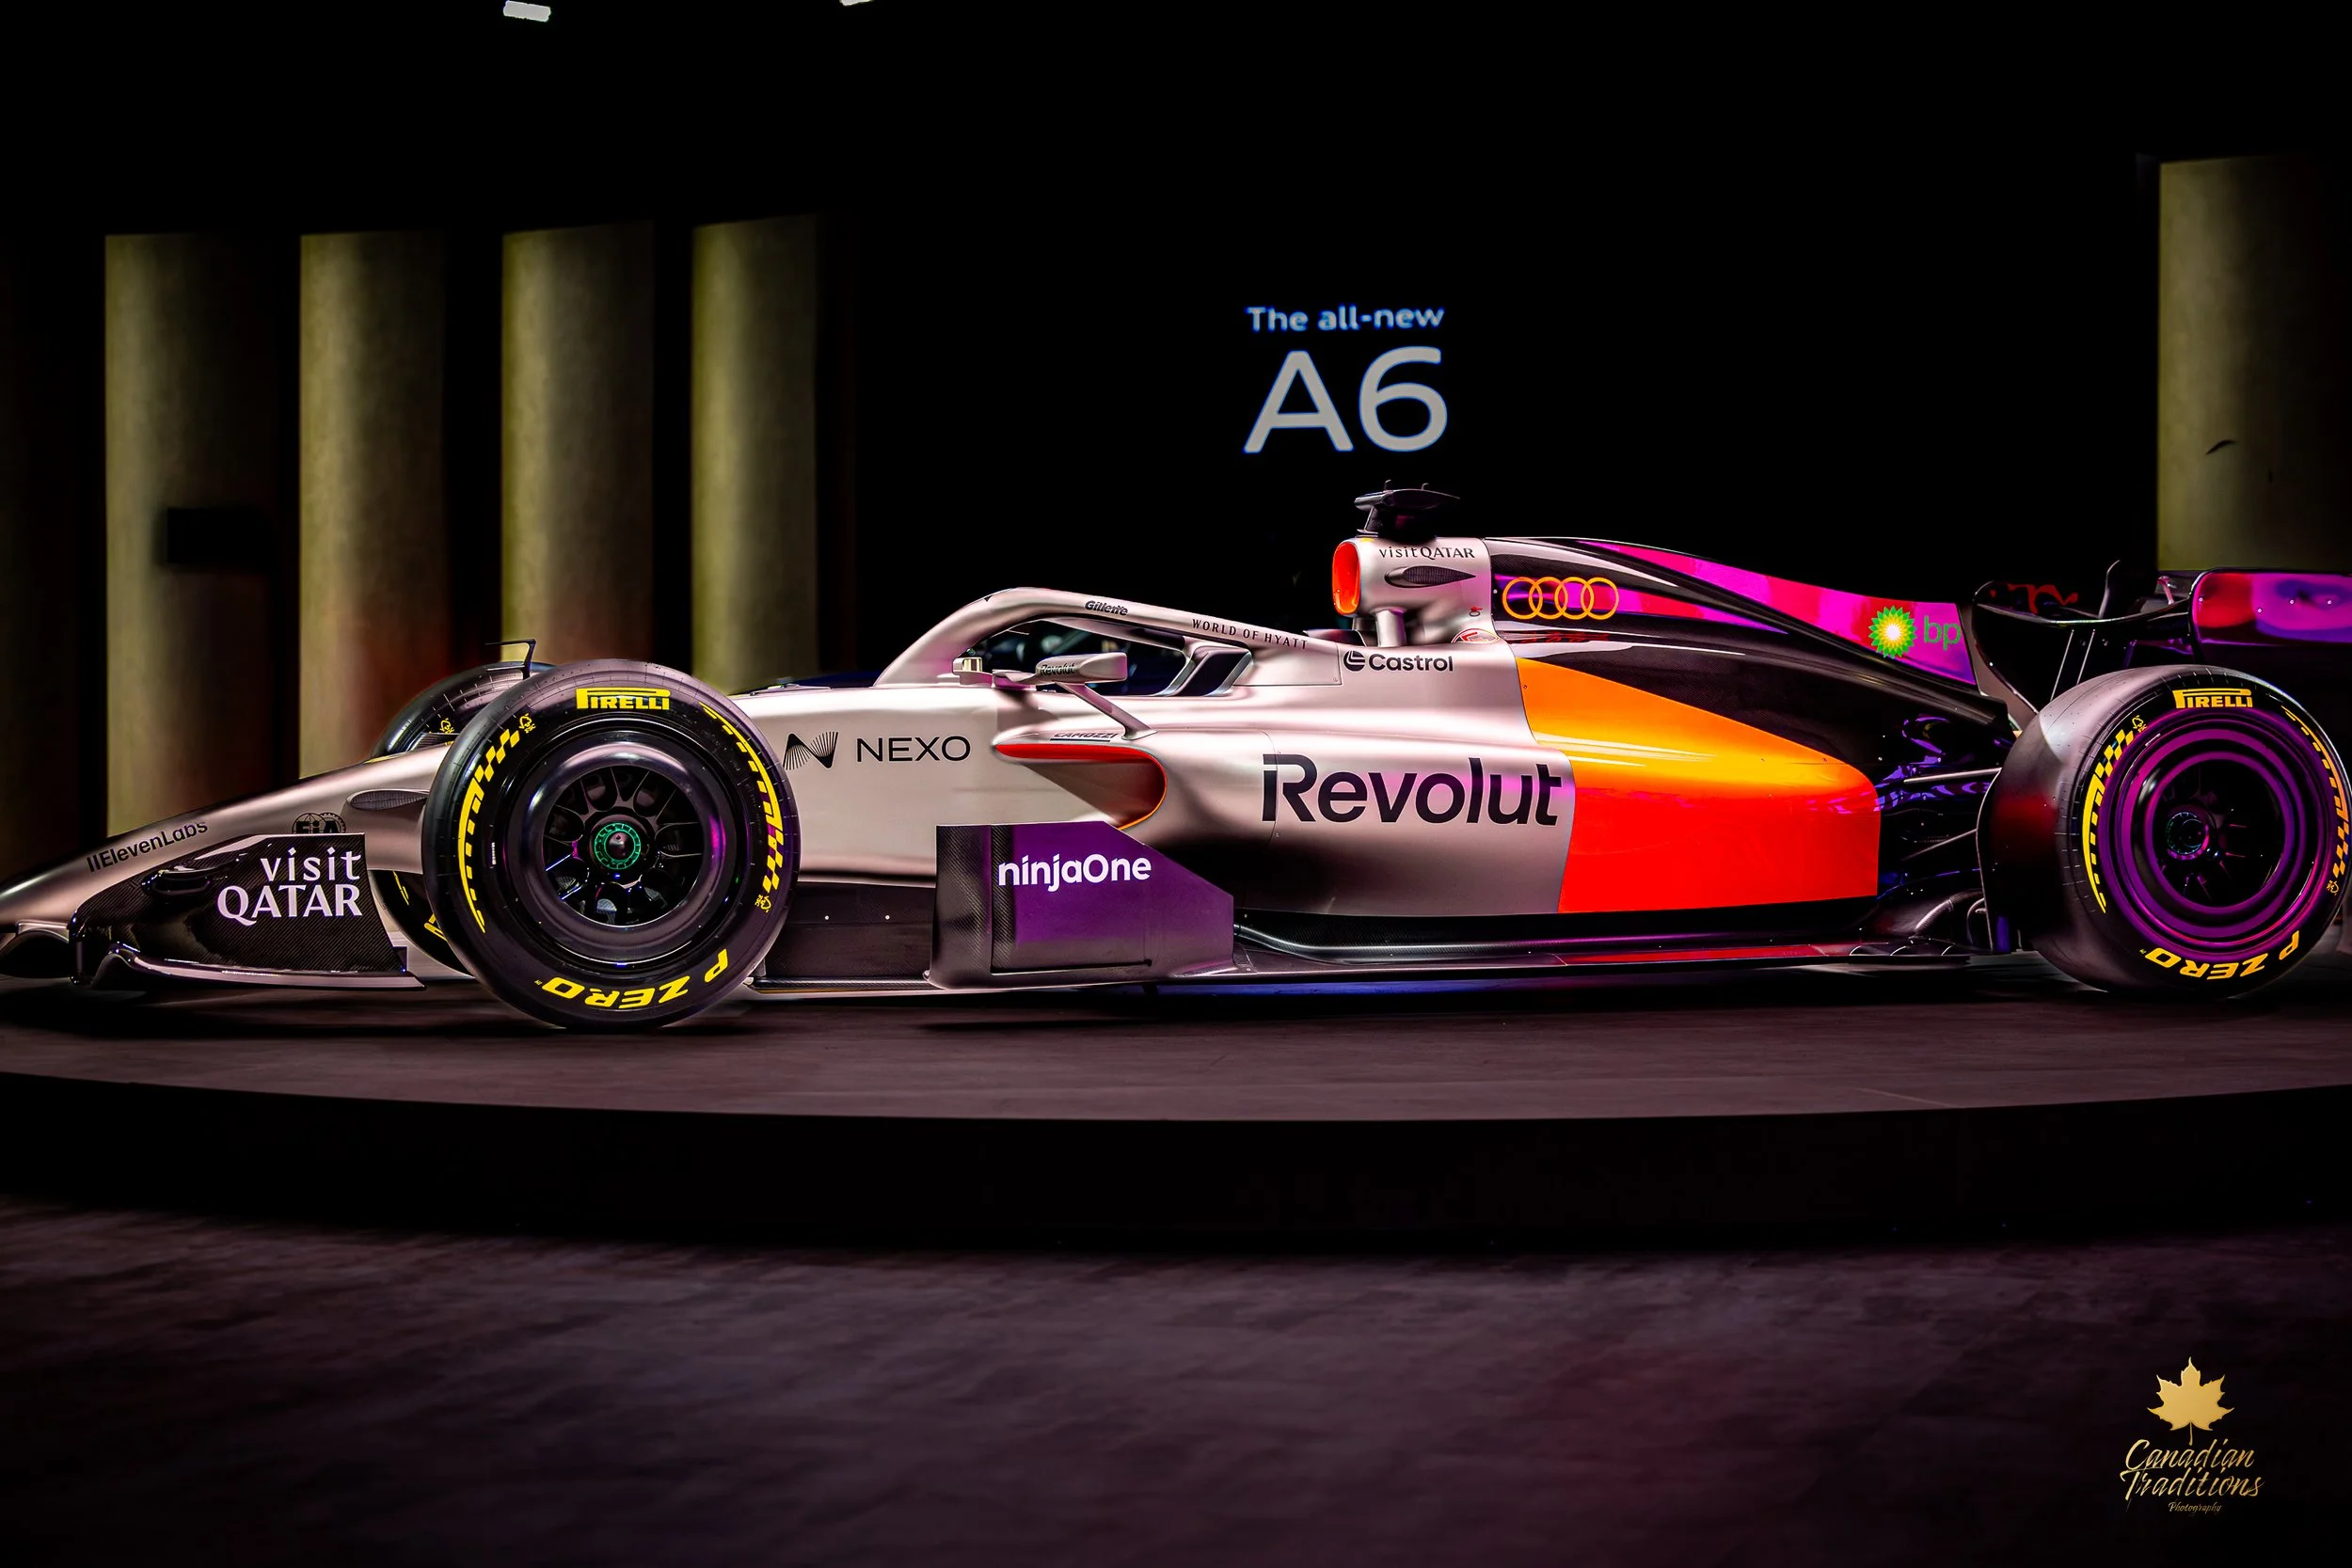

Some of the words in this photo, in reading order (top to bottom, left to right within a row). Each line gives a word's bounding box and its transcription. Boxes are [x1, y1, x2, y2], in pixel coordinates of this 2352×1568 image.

[1244, 306, 1309, 332] The
[1317, 303, 1445, 331] all-new
[1243, 345, 1448, 453] A6
[1085, 600, 1129, 616] Gillette
[1192, 618, 1237, 636] WORLD
[1243, 628, 1260, 641] OF
[1264, 633, 1308, 650] HYATT
[1923, 615, 1962, 651] bp
[1040, 662, 1075, 676] Revolut
[1369, 654, 1454, 672] Castrol
[576, 688, 671, 710] PIRELLI
[2172, 688, 2253, 709] PIRELLI
[856, 736, 971, 762] NEXO
[1262, 753, 1562, 826] Revolut
[260, 847, 362, 881] visit
[998, 853, 1152, 892] ninjaOne
[217, 884, 363, 927] QATAR
[2279, 930, 2299, 960] P
[704, 948, 729, 983] P
[2144, 947, 2268, 980] ZERO
[541, 975, 691, 1009] ZERO
